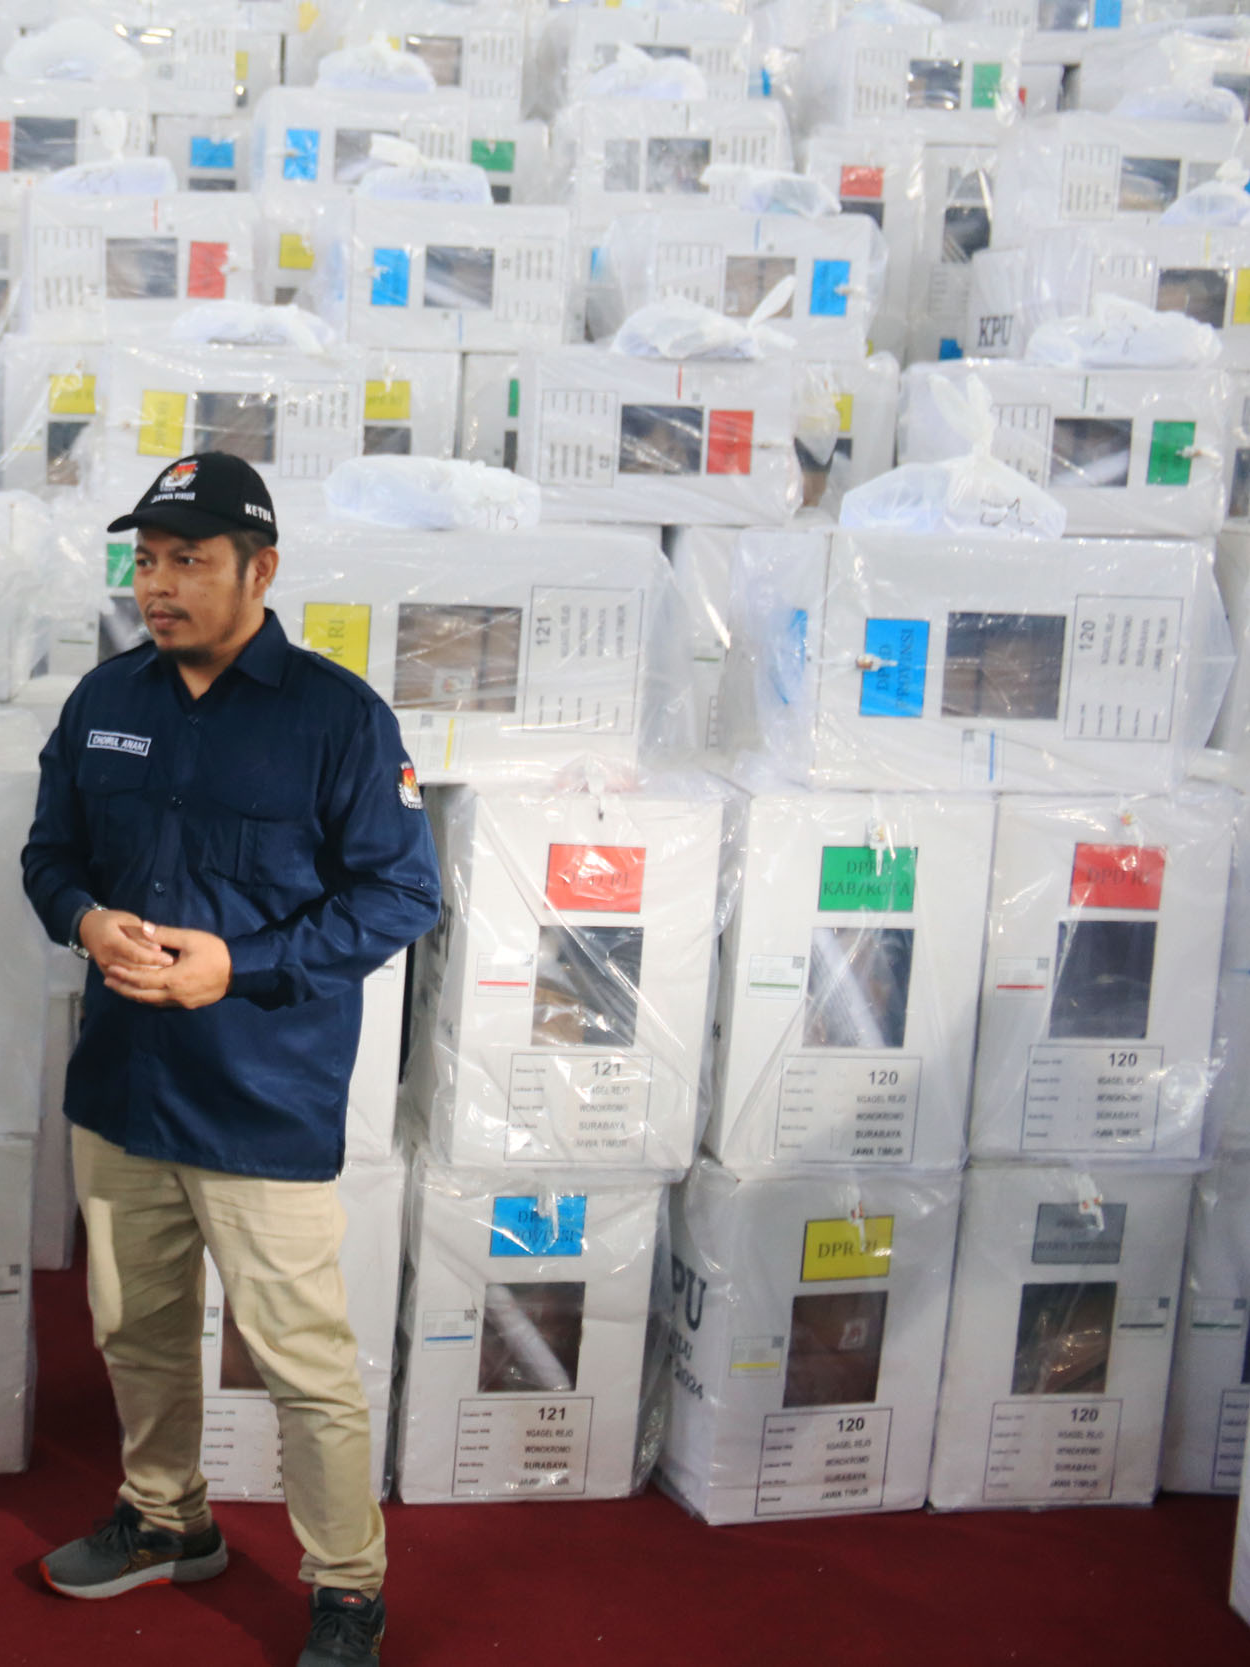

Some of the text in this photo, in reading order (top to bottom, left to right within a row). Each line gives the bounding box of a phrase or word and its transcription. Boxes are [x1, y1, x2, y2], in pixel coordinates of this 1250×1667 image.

[978, 315, 1013, 346] KPU
[536, 616, 551, 646] 121
[1078, 619, 1096, 651] 120
[876, 644, 892, 691] DPD
[121, 739, 146, 752] ANAM
[1109, 1052, 1138, 1068] 120
[592, 1062, 622, 1076] 121
[868, 1070, 899, 1086] 120
[578, 1121, 626, 1131] SURABAYA
[818, 1241, 854, 1258] DPR
[671, 1254, 707, 1332] PU
[538, 1407, 567, 1421] 121
[1070, 1407, 1099, 1423] 120
[837, 1417, 866, 1432] 120
[523, 1462, 569, 1470] SURABAYA
